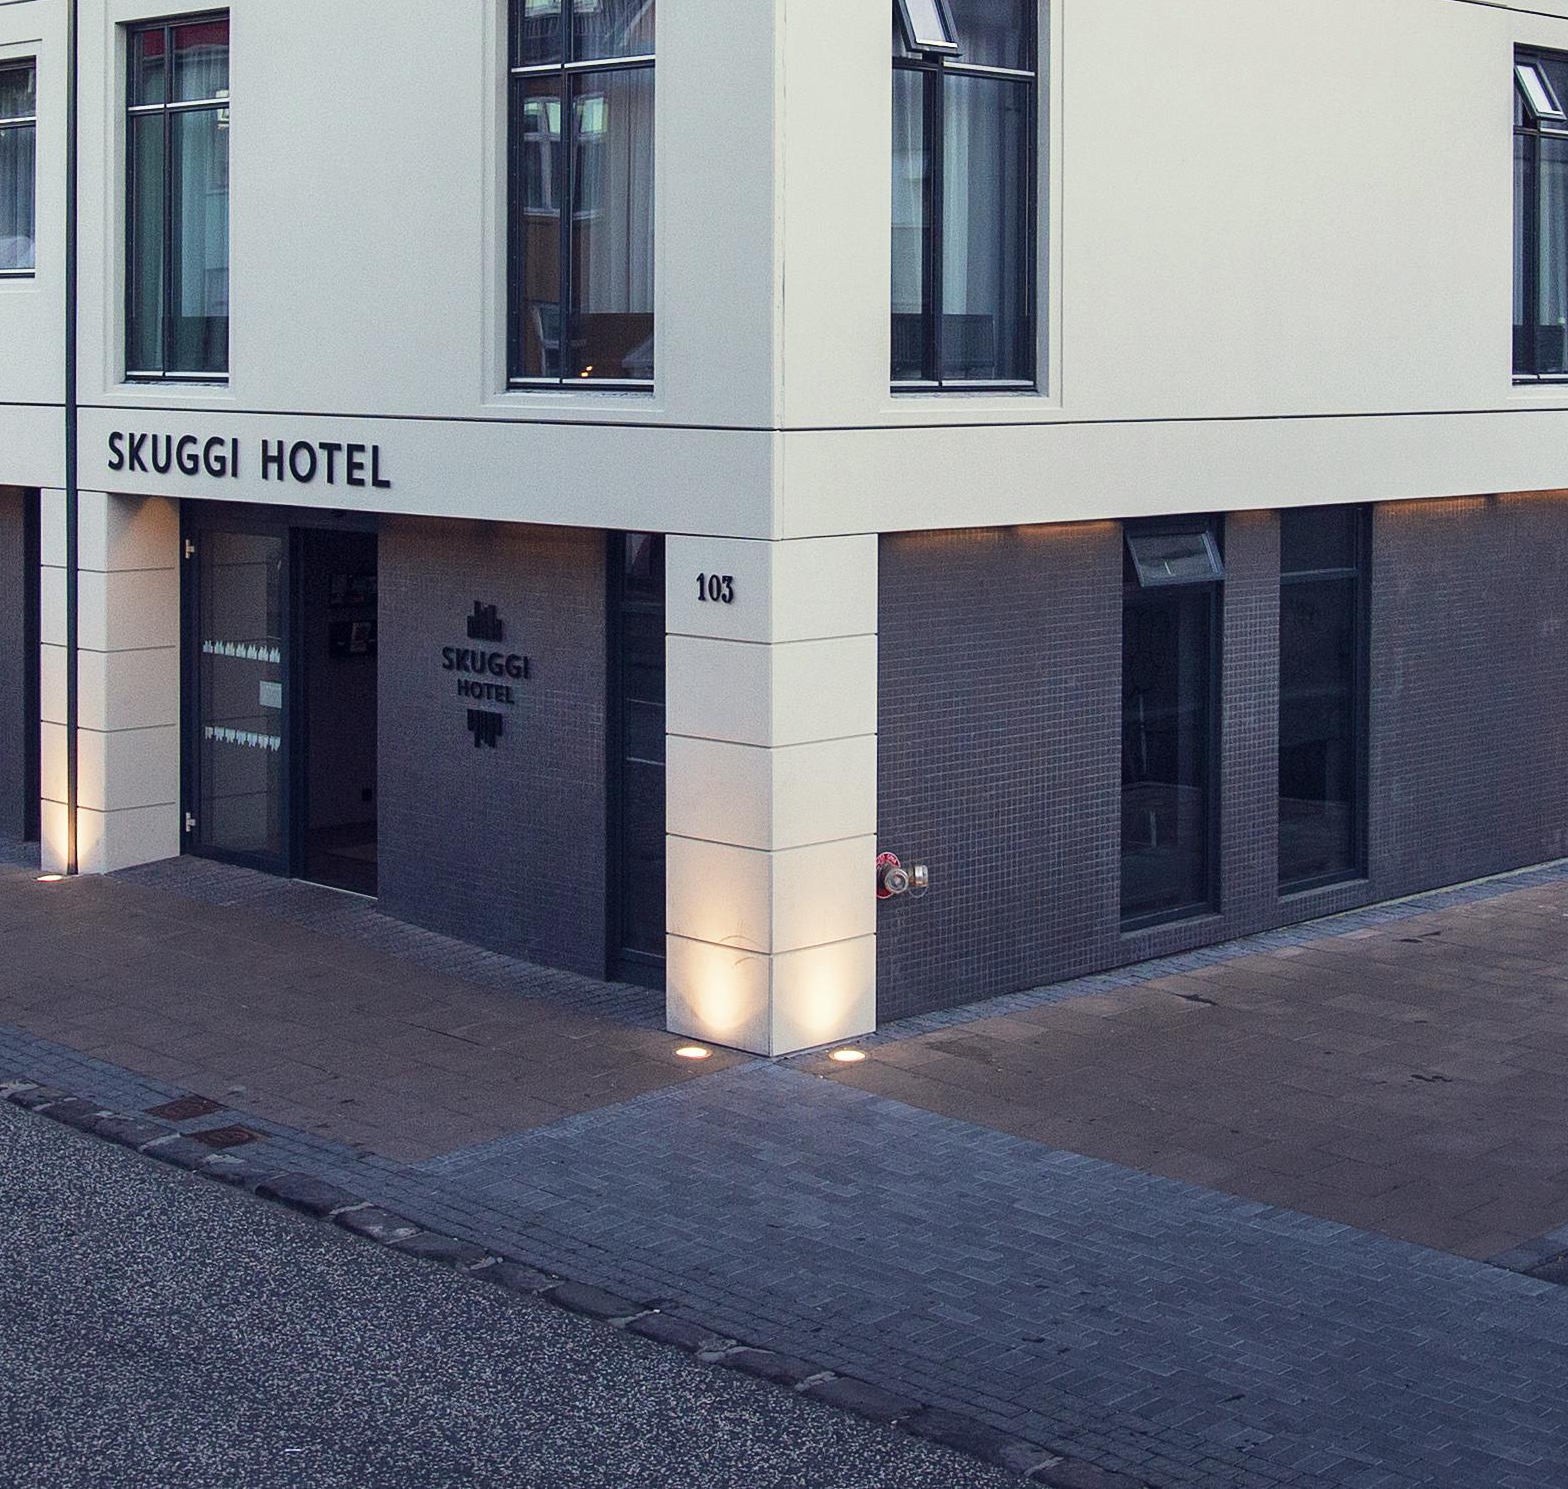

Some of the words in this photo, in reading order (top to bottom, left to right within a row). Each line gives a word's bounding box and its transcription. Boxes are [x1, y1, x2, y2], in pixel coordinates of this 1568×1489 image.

[107, 431, 239, 478] SKUGGI
[260, 439, 392, 489] HOTEL
[696, 572, 734, 604] 103
[441, 646, 530, 680] SKUGGI
[457, 678, 515, 705] HOTEL
